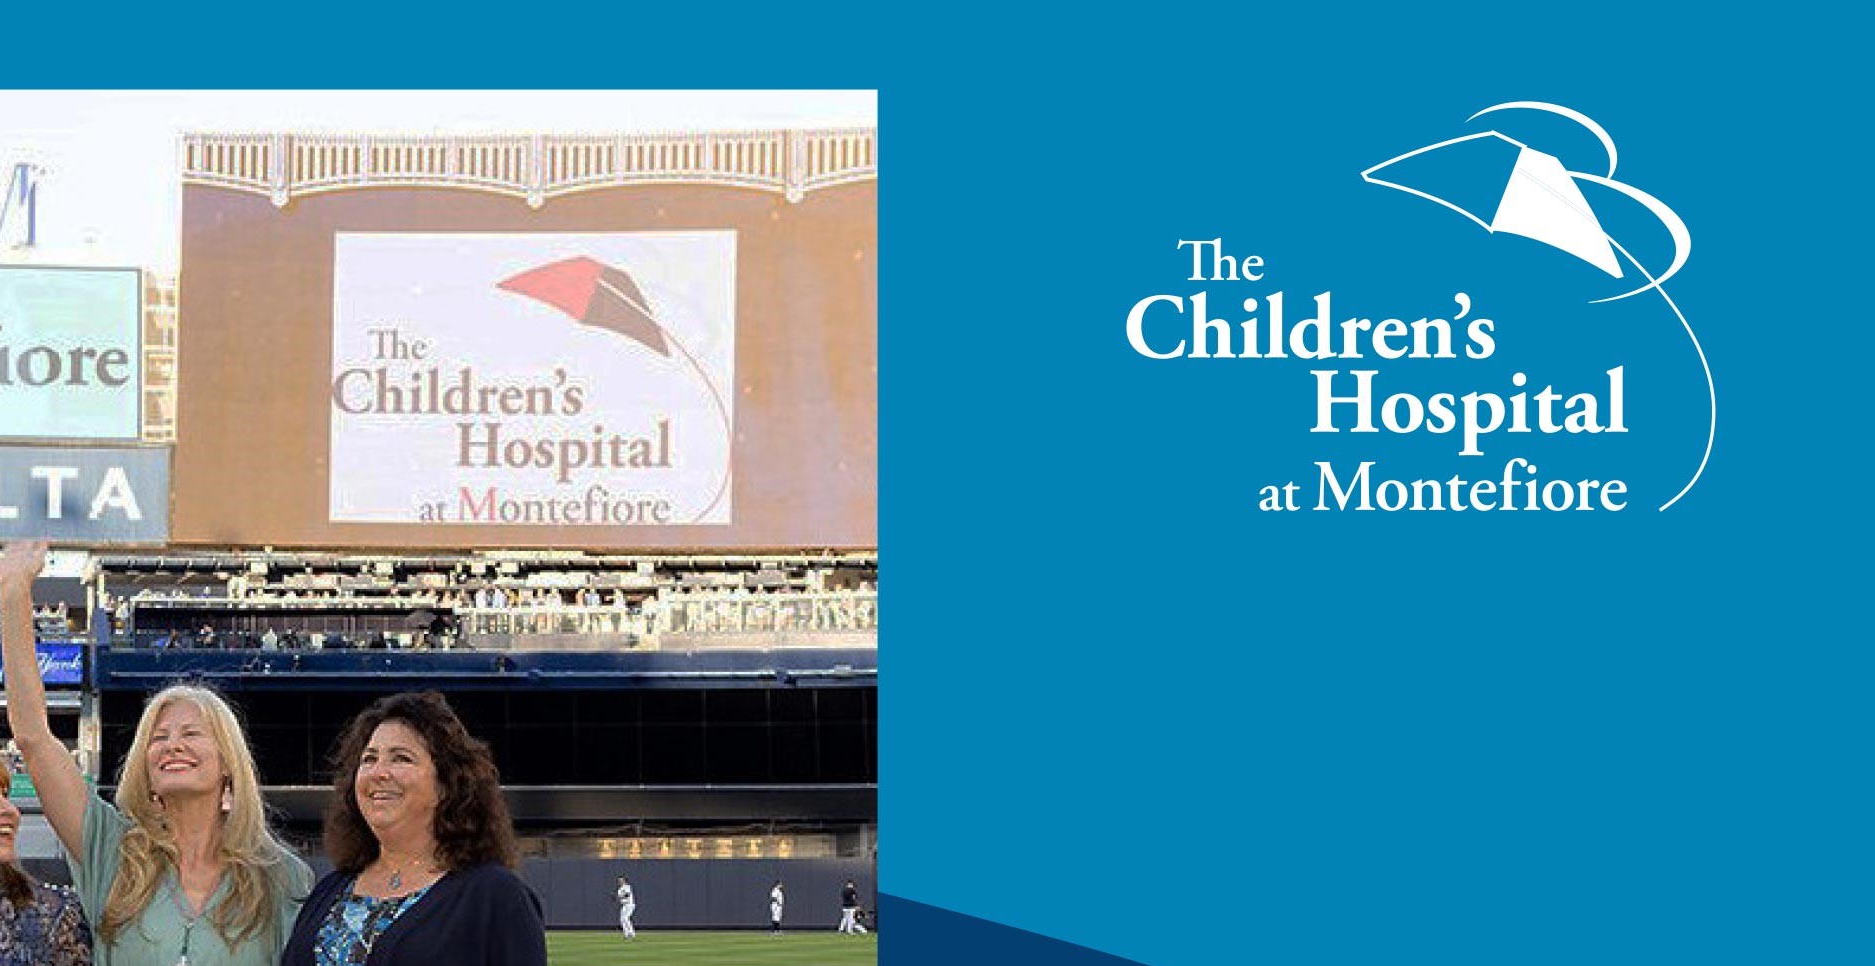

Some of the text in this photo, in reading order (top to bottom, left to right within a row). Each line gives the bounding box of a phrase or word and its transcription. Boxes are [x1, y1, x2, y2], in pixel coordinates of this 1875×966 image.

[368, 327, 425, 361] The
[456, 419, 673, 484] Hospital
[418, 486, 672, 522] at Montefiore
